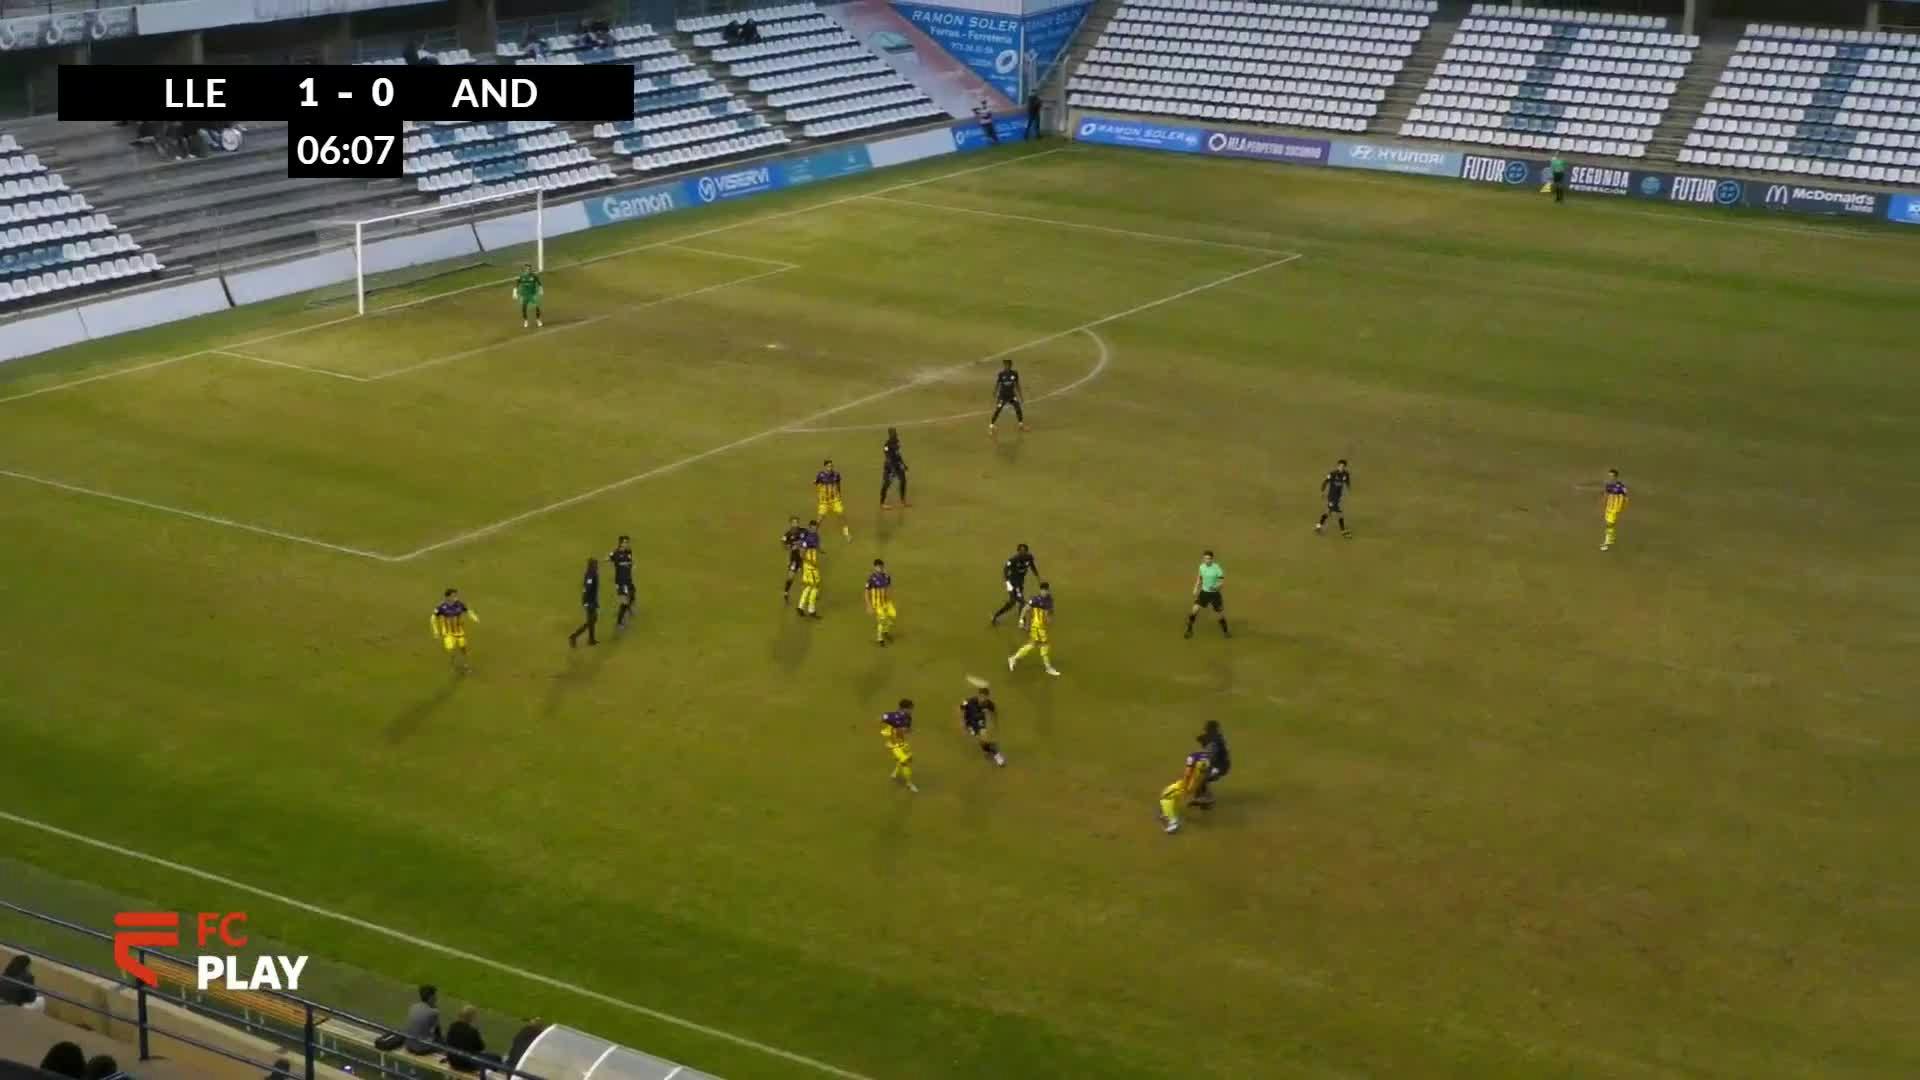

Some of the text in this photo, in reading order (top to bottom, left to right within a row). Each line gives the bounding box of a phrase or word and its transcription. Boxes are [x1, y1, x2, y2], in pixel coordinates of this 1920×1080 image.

[968, 17, 1018, 32] SOLER
[1376, 149, 1445, 164] HYUNDAI
[715, 167, 769, 191] VISERVI
[1462, 156, 1506, 183] FUTUR
[1570, 166, 1630, 188] SEGUNDA
[1671, 176, 1717, 202] FUTUR
[1792, 187, 1875, 205] McDonald's
